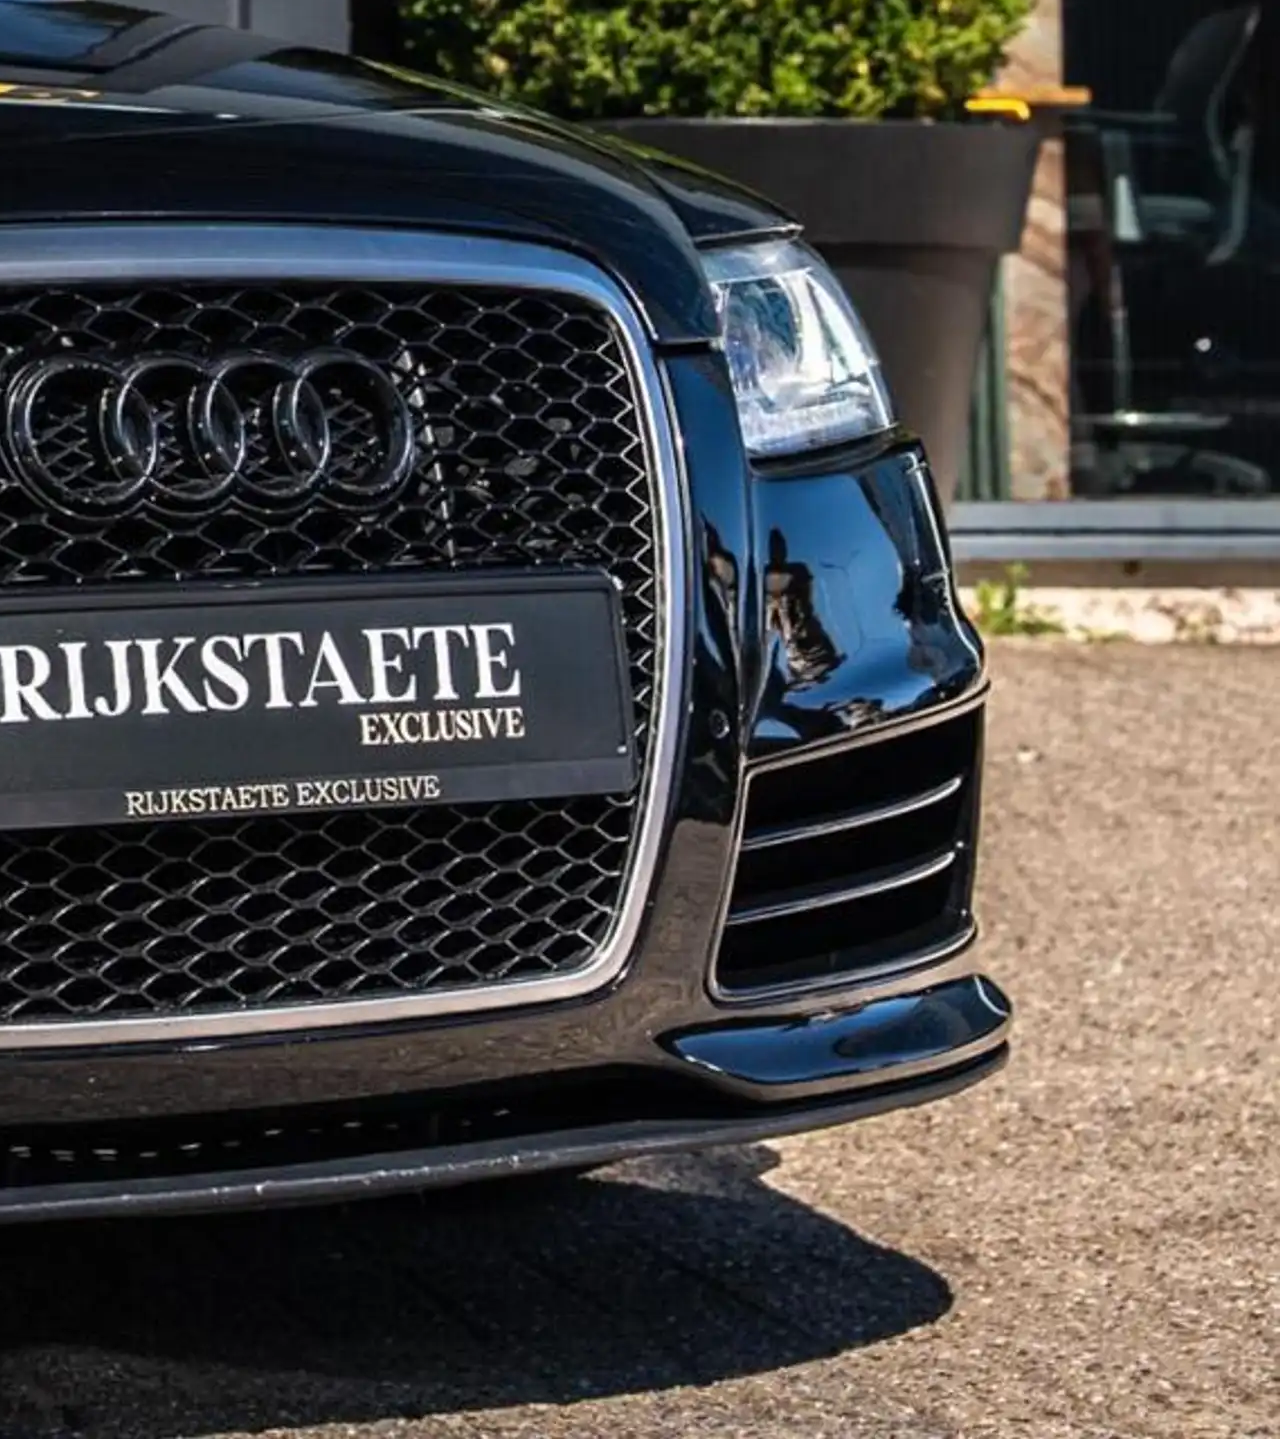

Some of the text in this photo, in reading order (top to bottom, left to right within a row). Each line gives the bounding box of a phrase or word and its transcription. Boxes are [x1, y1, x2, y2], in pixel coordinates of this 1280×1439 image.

[359, 706, 526, 747] EXCLUSIVE
[124, 774, 441, 817] RIJKSTAETE EXCLUSIVE
